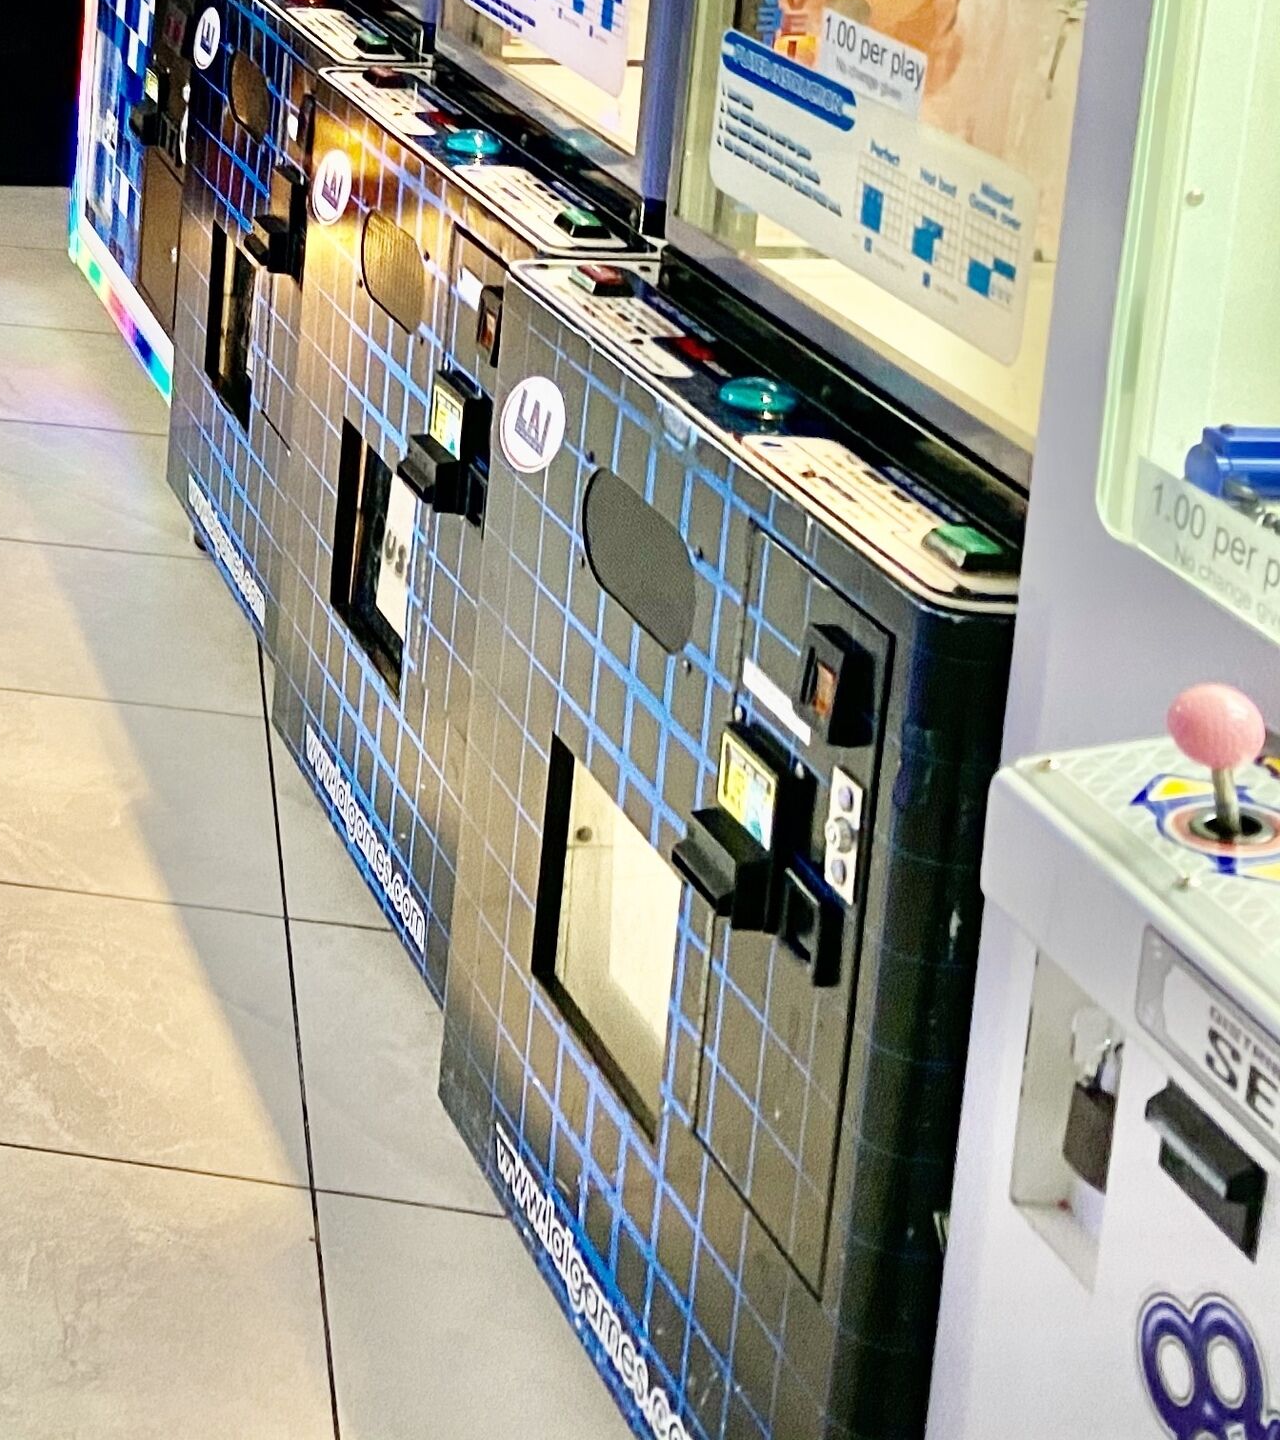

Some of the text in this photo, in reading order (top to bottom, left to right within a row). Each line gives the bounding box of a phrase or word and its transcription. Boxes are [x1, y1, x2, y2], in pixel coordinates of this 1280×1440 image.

[825, 15, 925, 90] 1.00 per play
[321, 172, 344, 213] LAI
[514, 388, 553, 458] LAI
[1152, 482, 1259, 571] 1.00 per
[305, 722, 427, 956] www.laigames.com
